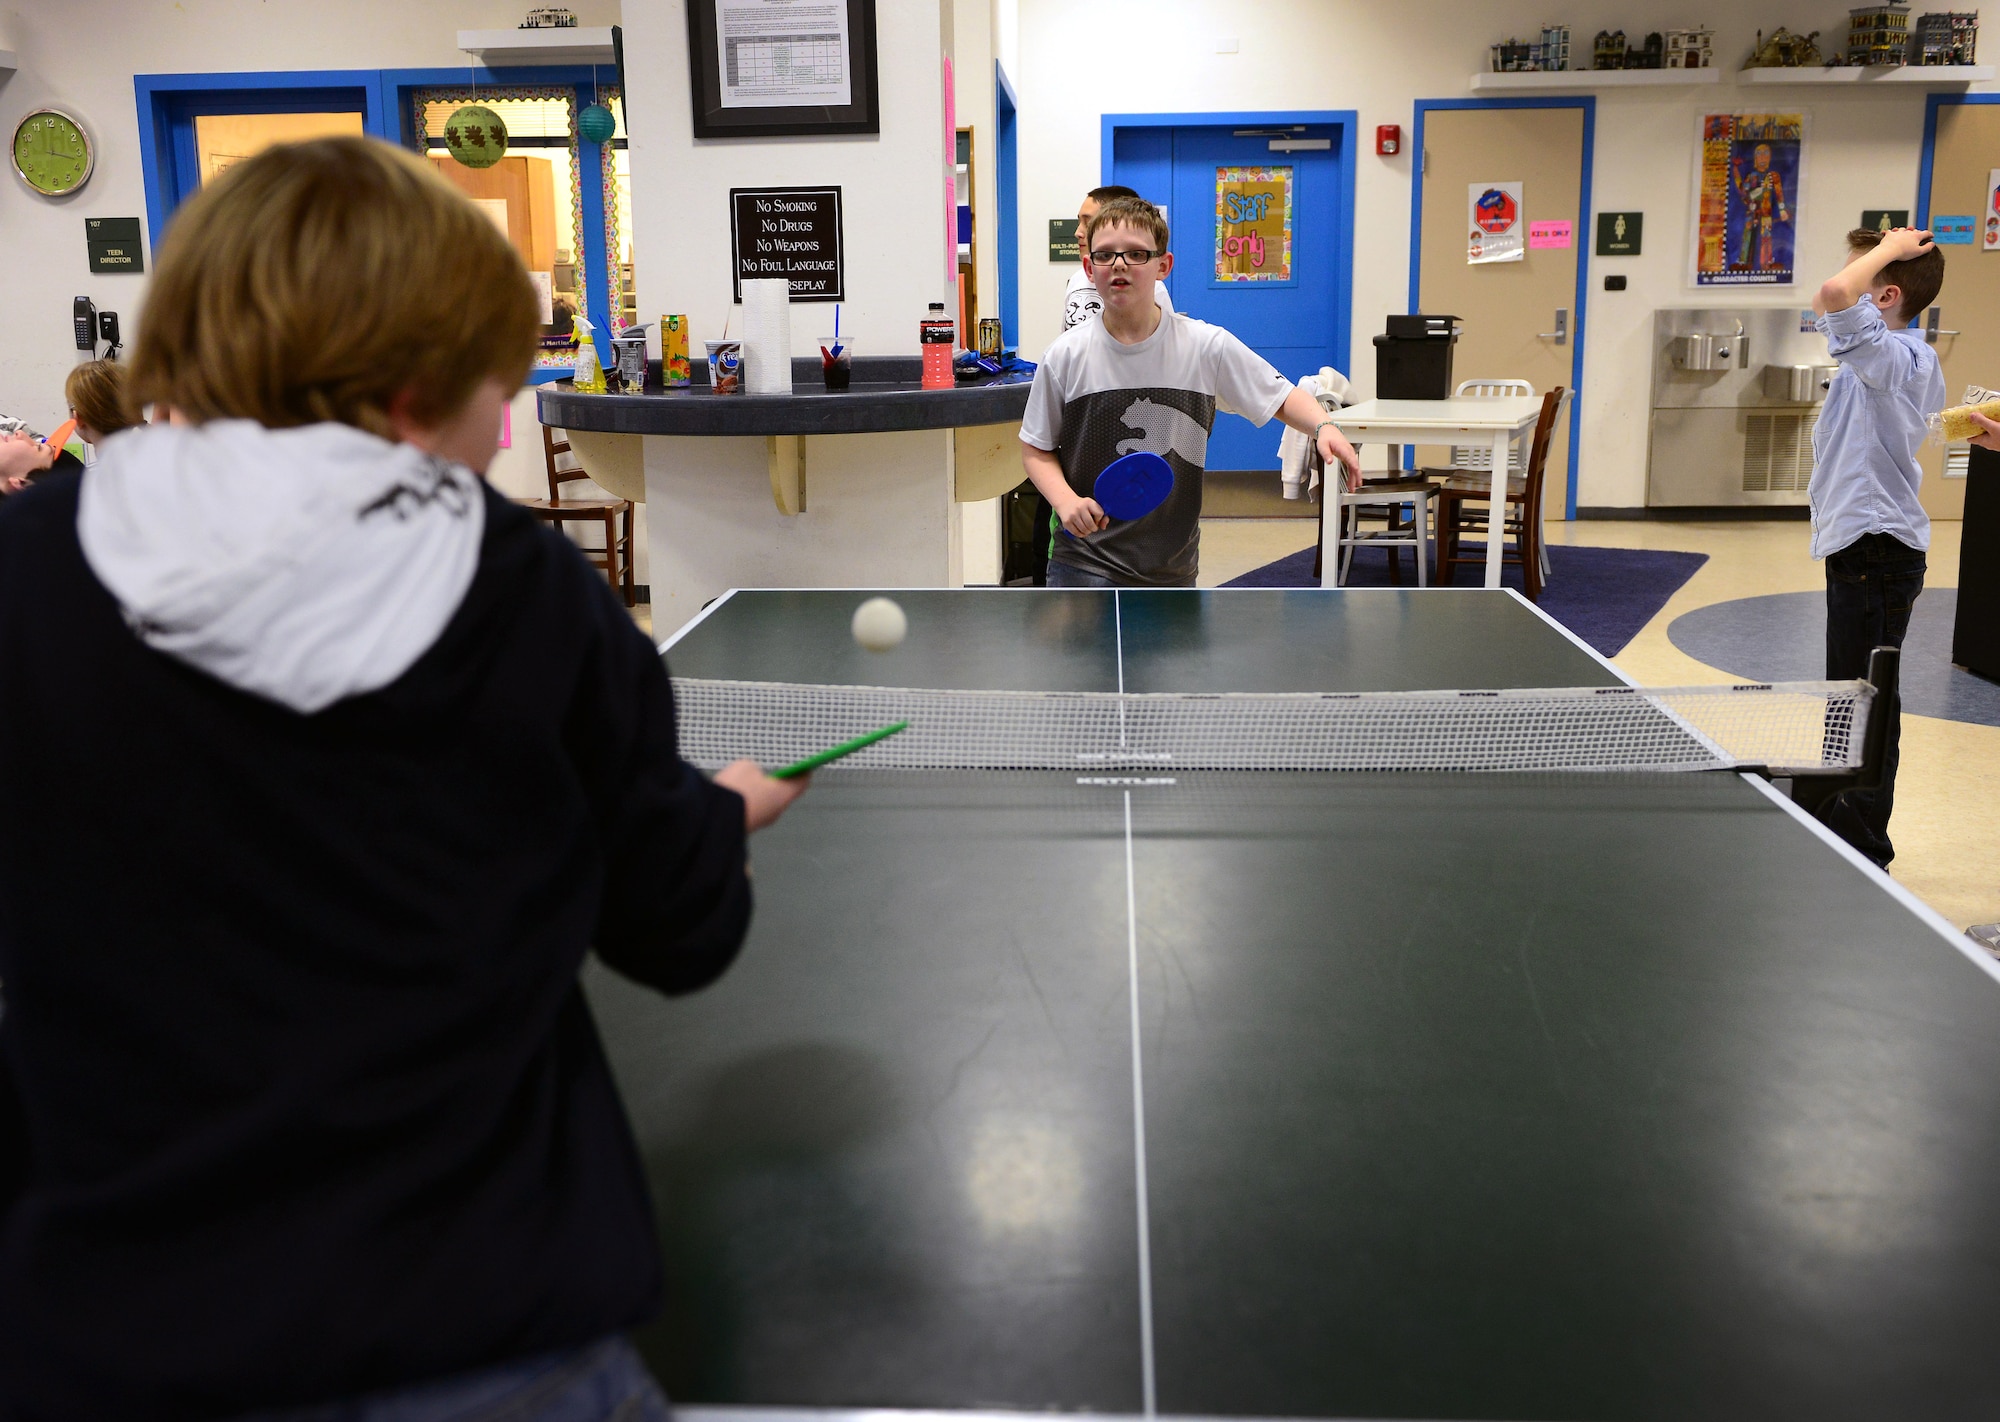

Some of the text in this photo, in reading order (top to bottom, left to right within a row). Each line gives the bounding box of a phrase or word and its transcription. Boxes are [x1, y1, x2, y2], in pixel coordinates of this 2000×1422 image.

[32, 123, 40, 131] 11
[45, 119, 54, 128] 12
[71, 133, 77, 142] 2
[1225, 191, 1274, 224] Staff
[788, 280, 826, 290] RSEPLAY
